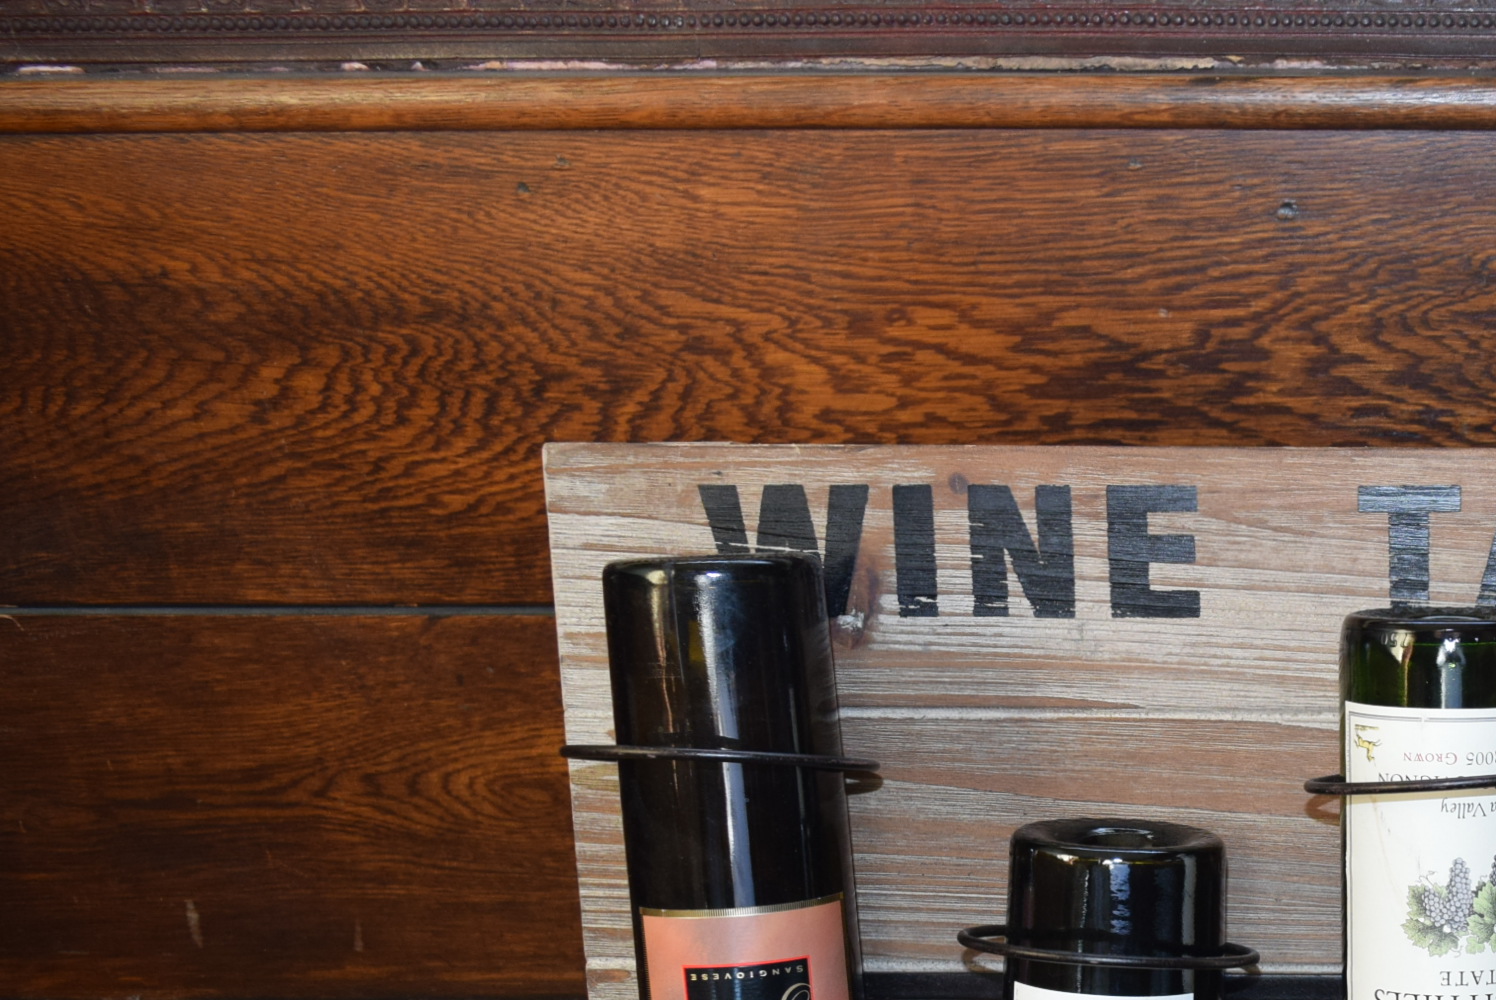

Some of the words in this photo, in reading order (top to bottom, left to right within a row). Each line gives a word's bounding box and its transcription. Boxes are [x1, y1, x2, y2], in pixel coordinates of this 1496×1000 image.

[697, 484, 1201, 620] WINE
[1402, 751, 1458, 767] GROWN
[1440, 797, 1487, 819] Valley
[690, 964, 803, 981] SANGIOVESE
